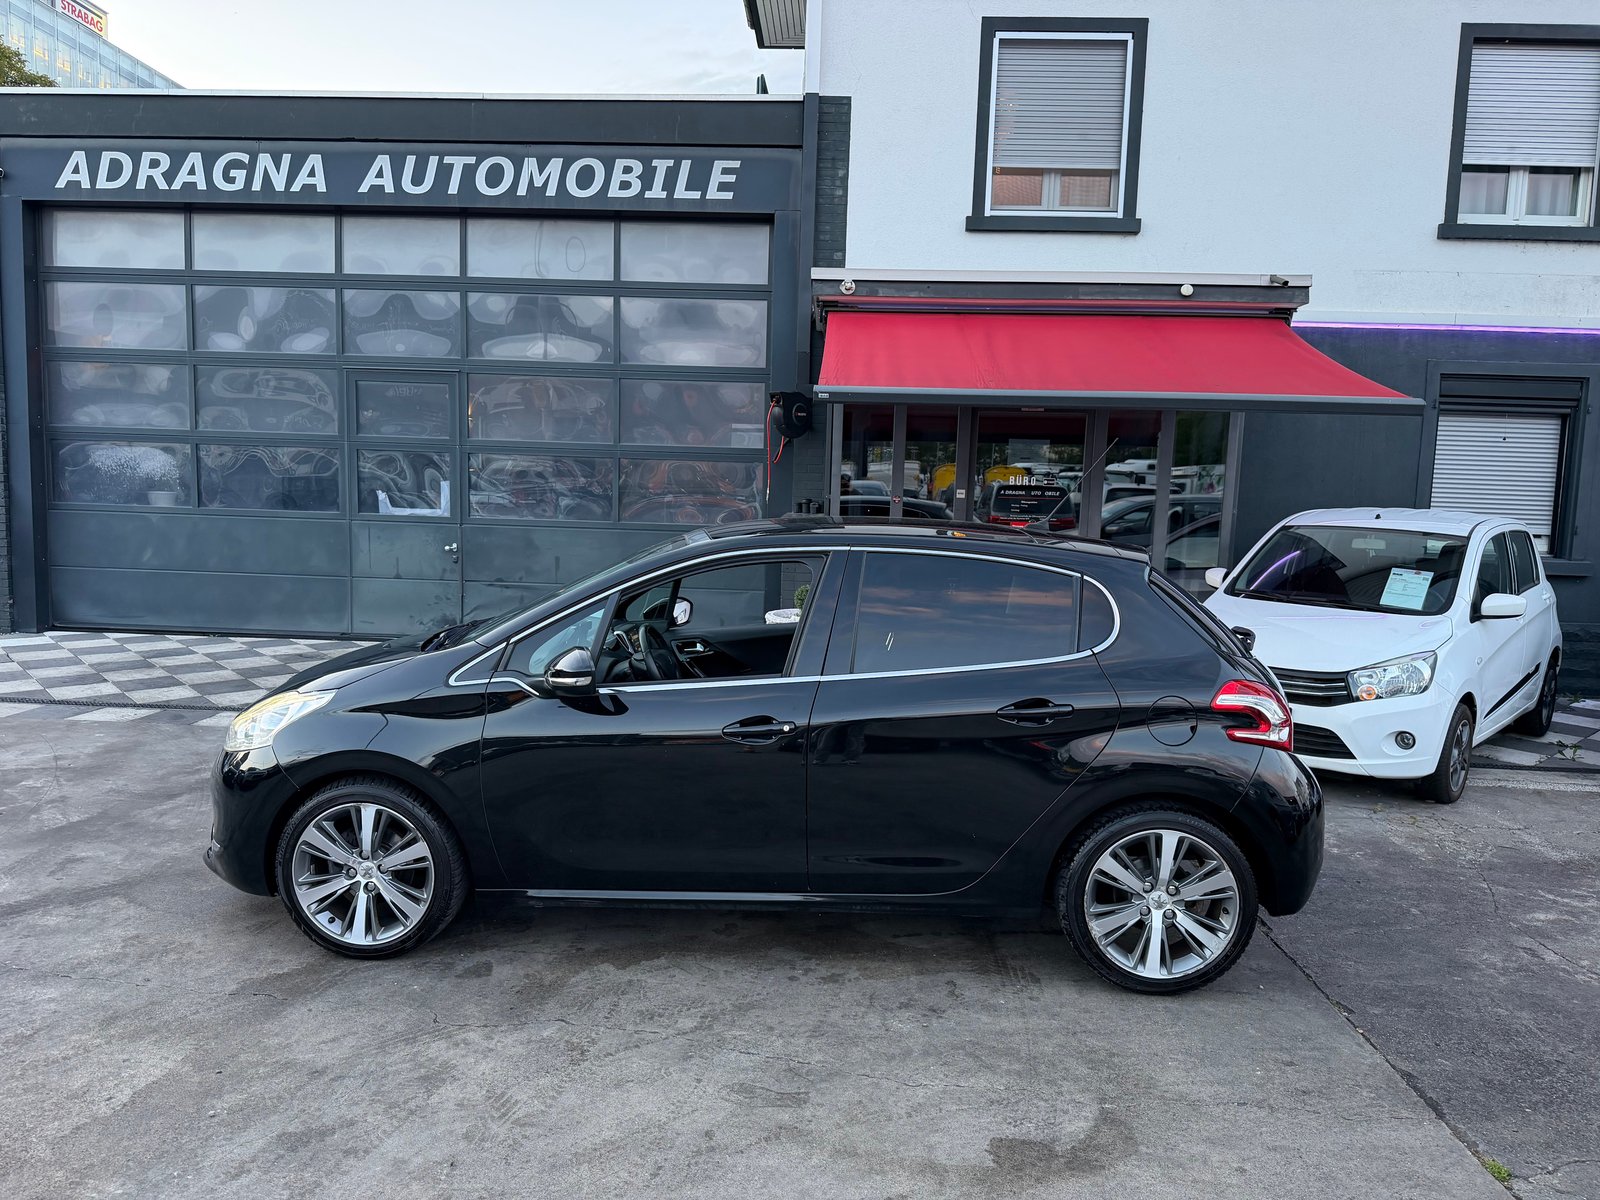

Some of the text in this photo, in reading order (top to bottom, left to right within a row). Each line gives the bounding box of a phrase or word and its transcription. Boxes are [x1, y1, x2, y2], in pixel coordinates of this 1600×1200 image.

[61, 0, 103, 32] STRABAG
[55, 150, 741, 201] ADRAGNA AUTOMOBILE
[1009, 475, 1036, 486] BÜRO
